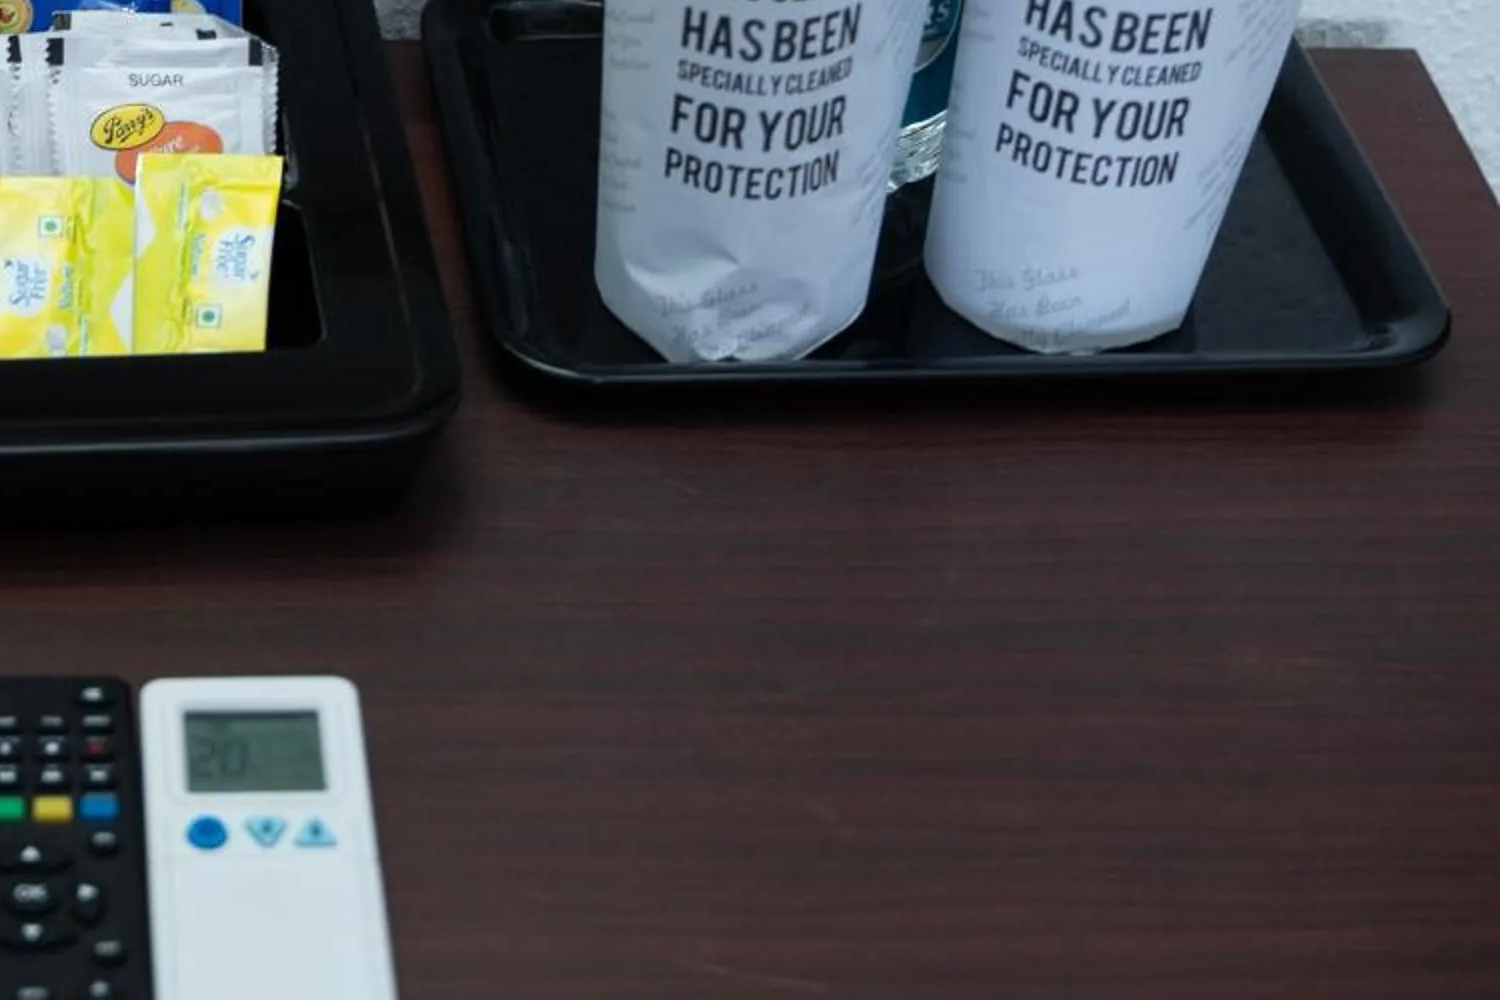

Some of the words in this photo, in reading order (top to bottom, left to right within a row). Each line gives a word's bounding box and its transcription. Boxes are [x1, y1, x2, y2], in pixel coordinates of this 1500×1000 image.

[681, 6, 764, 62] HAS
[774, 4, 862, 64] BEEN
[1111, 8, 1213, 54] BEEN
[128, 73, 183, 87] SUGAR
[677, 59, 782, 97] SPECIALLY
[784, 56, 853, 96] CLEANED
[1017, 36, 1120, 85] SPECIALLY
[1120, 61, 1203, 88] CLEANED
[670, 93, 747, 152] FOR
[758, 94, 847, 153] YOUR
[1005, 70, 1081, 135] FOR
[1090, 97, 1191, 142] YOUR
[664, 147, 841, 200] PROTECTION
[995, 122, 1180, 188] PROTECTION
